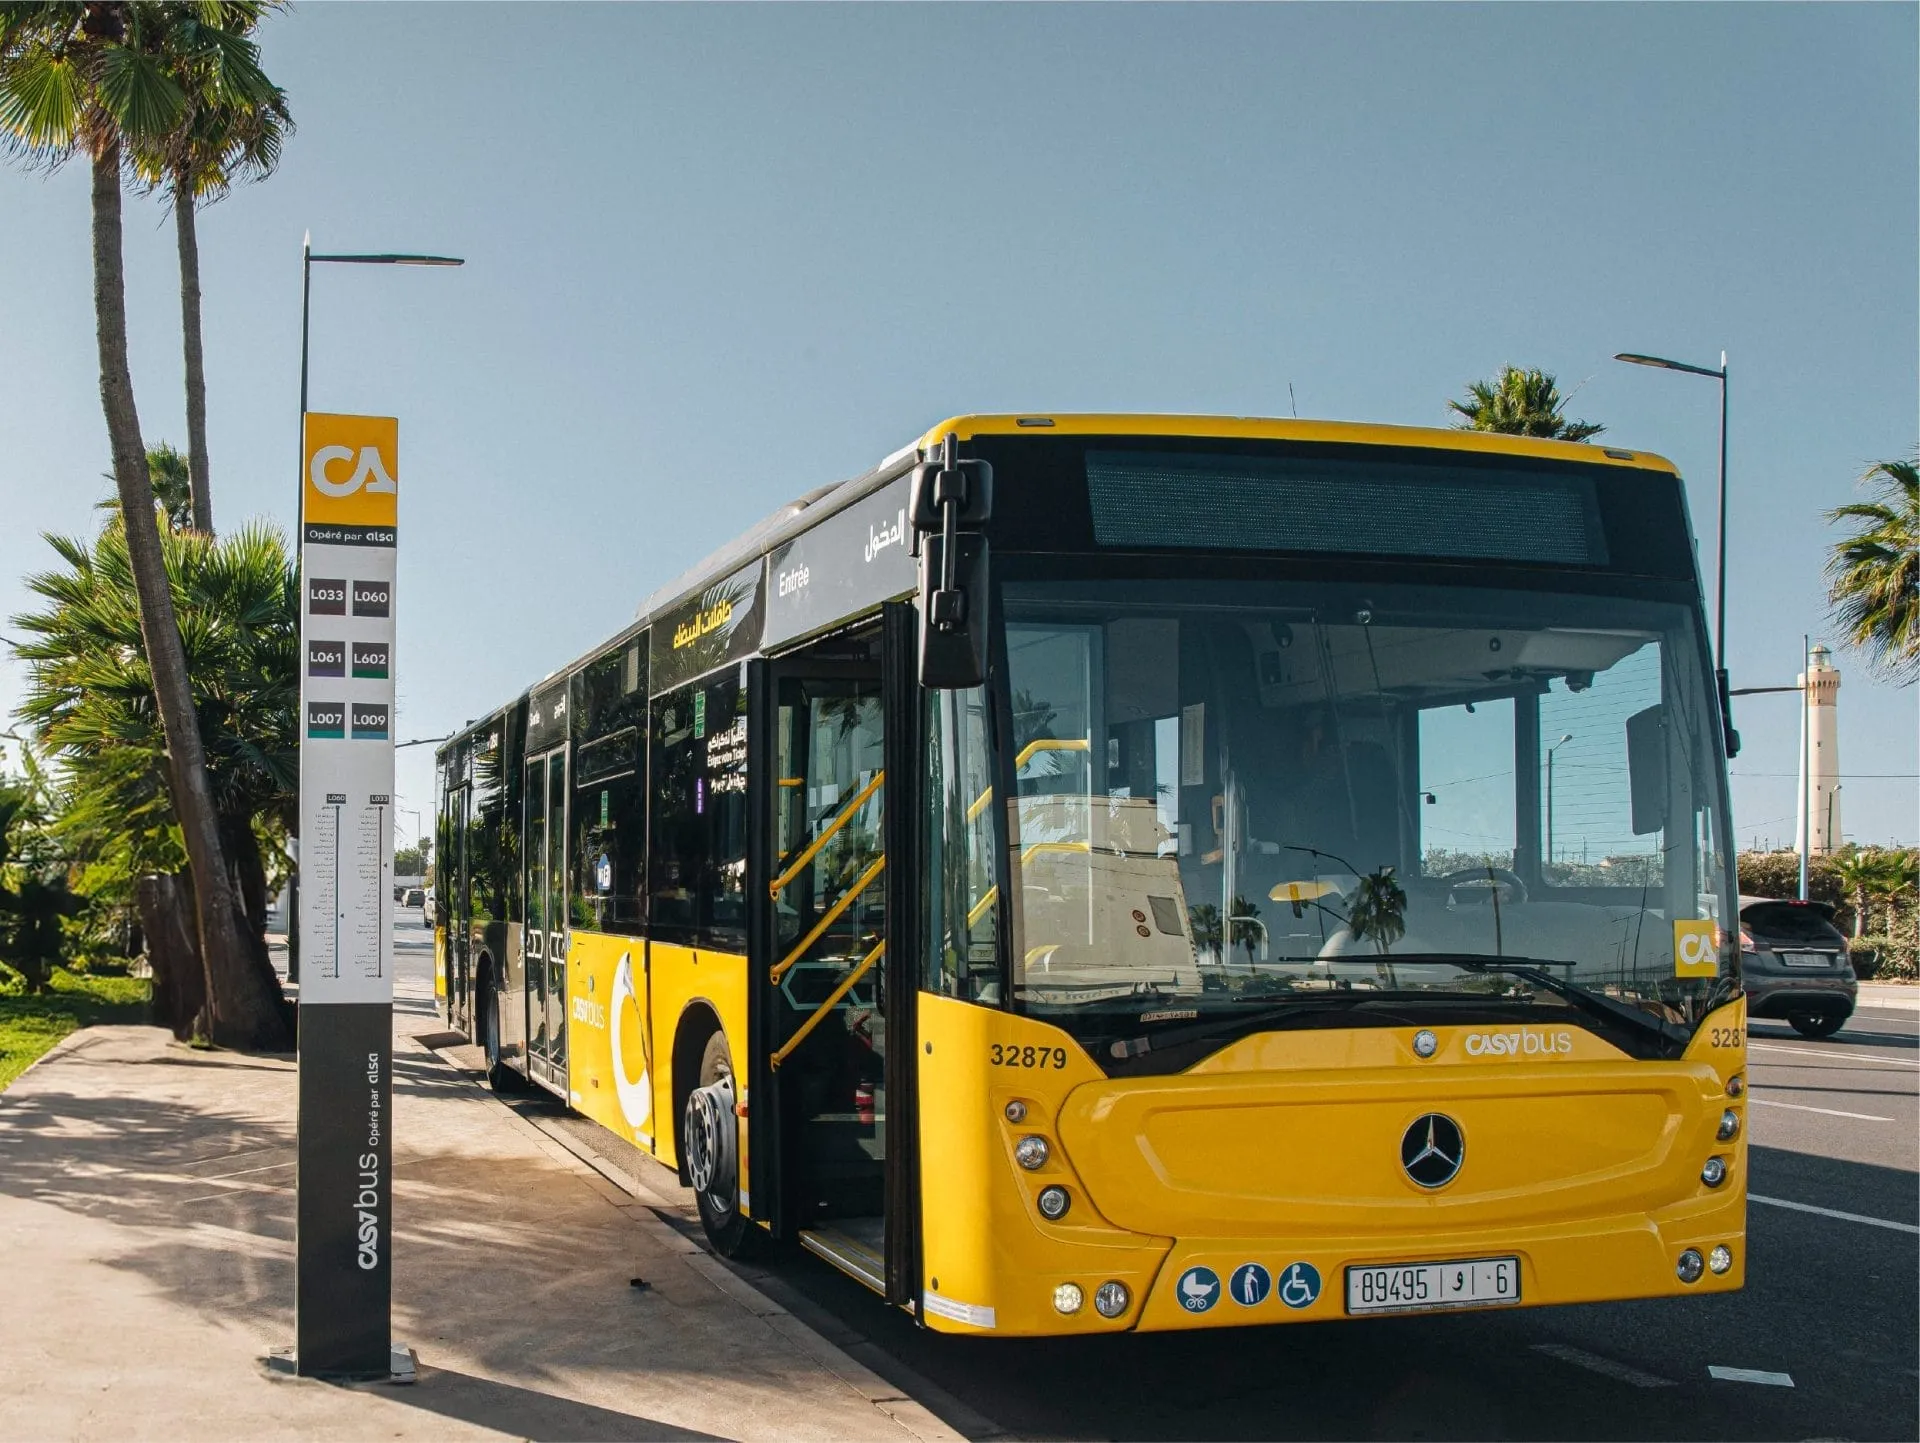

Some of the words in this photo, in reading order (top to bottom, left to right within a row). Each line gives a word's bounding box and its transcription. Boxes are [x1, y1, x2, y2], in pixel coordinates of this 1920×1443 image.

[309, 529, 342, 542] Opéré
[344, 533, 363, 542] par
[366, 531, 394, 542] alsa
[778, 563, 809, 597] Entrée
[310, 589, 344, 601] L033
[354, 591, 388, 603] L060
[310, 652, 342, 663] L061
[354, 653, 386, 664] L602
[309, 713, 343, 724] L007
[353, 714, 386, 726] L009
[1678, 933, 1718, 965] CA
[990, 1043, 1067, 1069] 32879
[367, 1053, 378, 1084] alsa
[371, 1088, 381, 1108] par
[368, 1110, 381, 1146] opéré
[1362, 1269, 1428, 1303] 89495
[1496, 1264, 1508, 1294] 6
